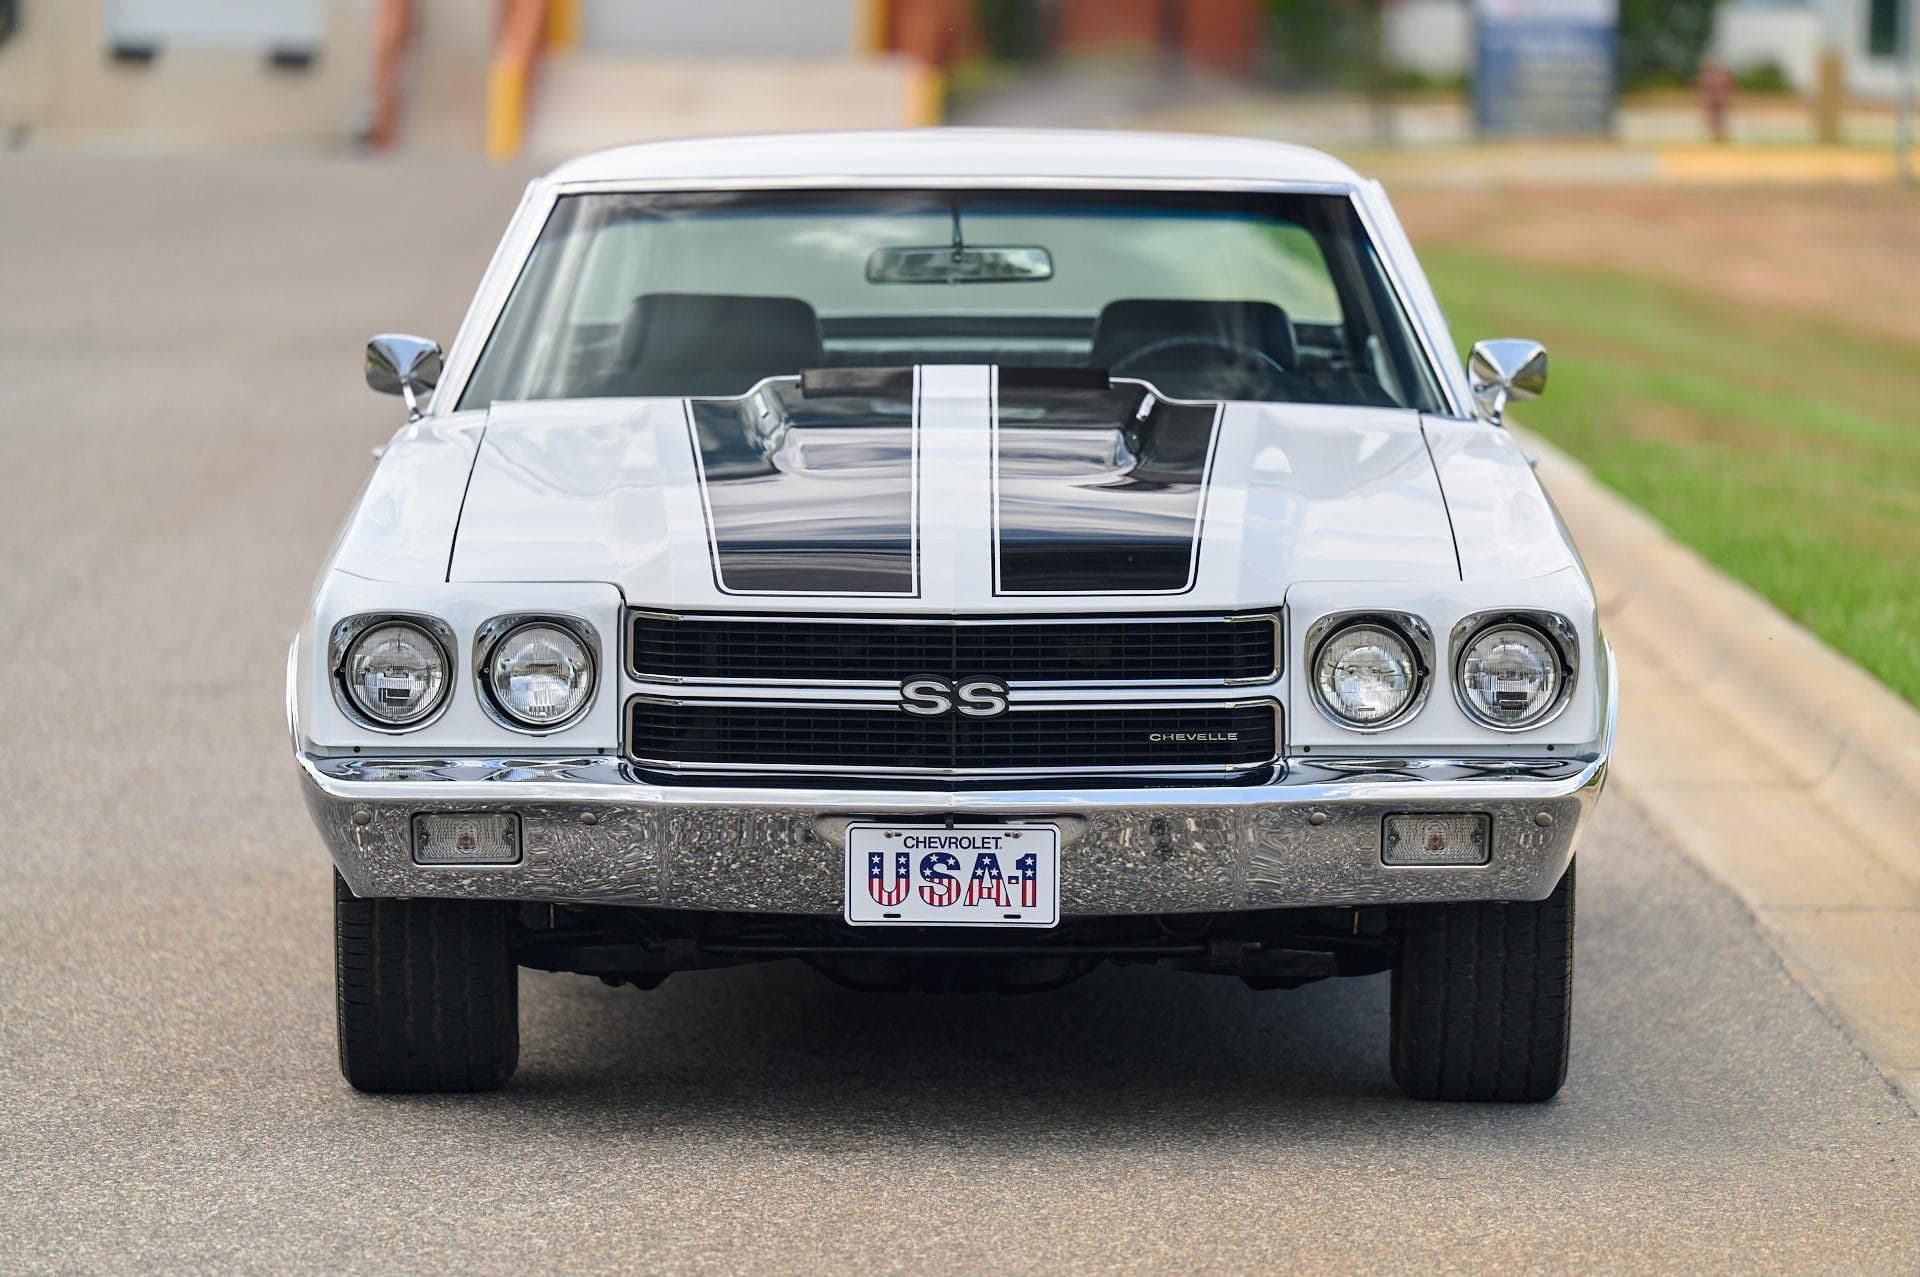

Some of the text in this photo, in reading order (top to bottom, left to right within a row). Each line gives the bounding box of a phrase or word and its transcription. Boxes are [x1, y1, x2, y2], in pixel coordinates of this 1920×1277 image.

[902, 681, 1006, 716] SS
[1149, 732, 1238, 741] CHEVELLE
[903, 836, 1002, 850] CHEVROLET
[868, 851, 1037, 908] USA-1
